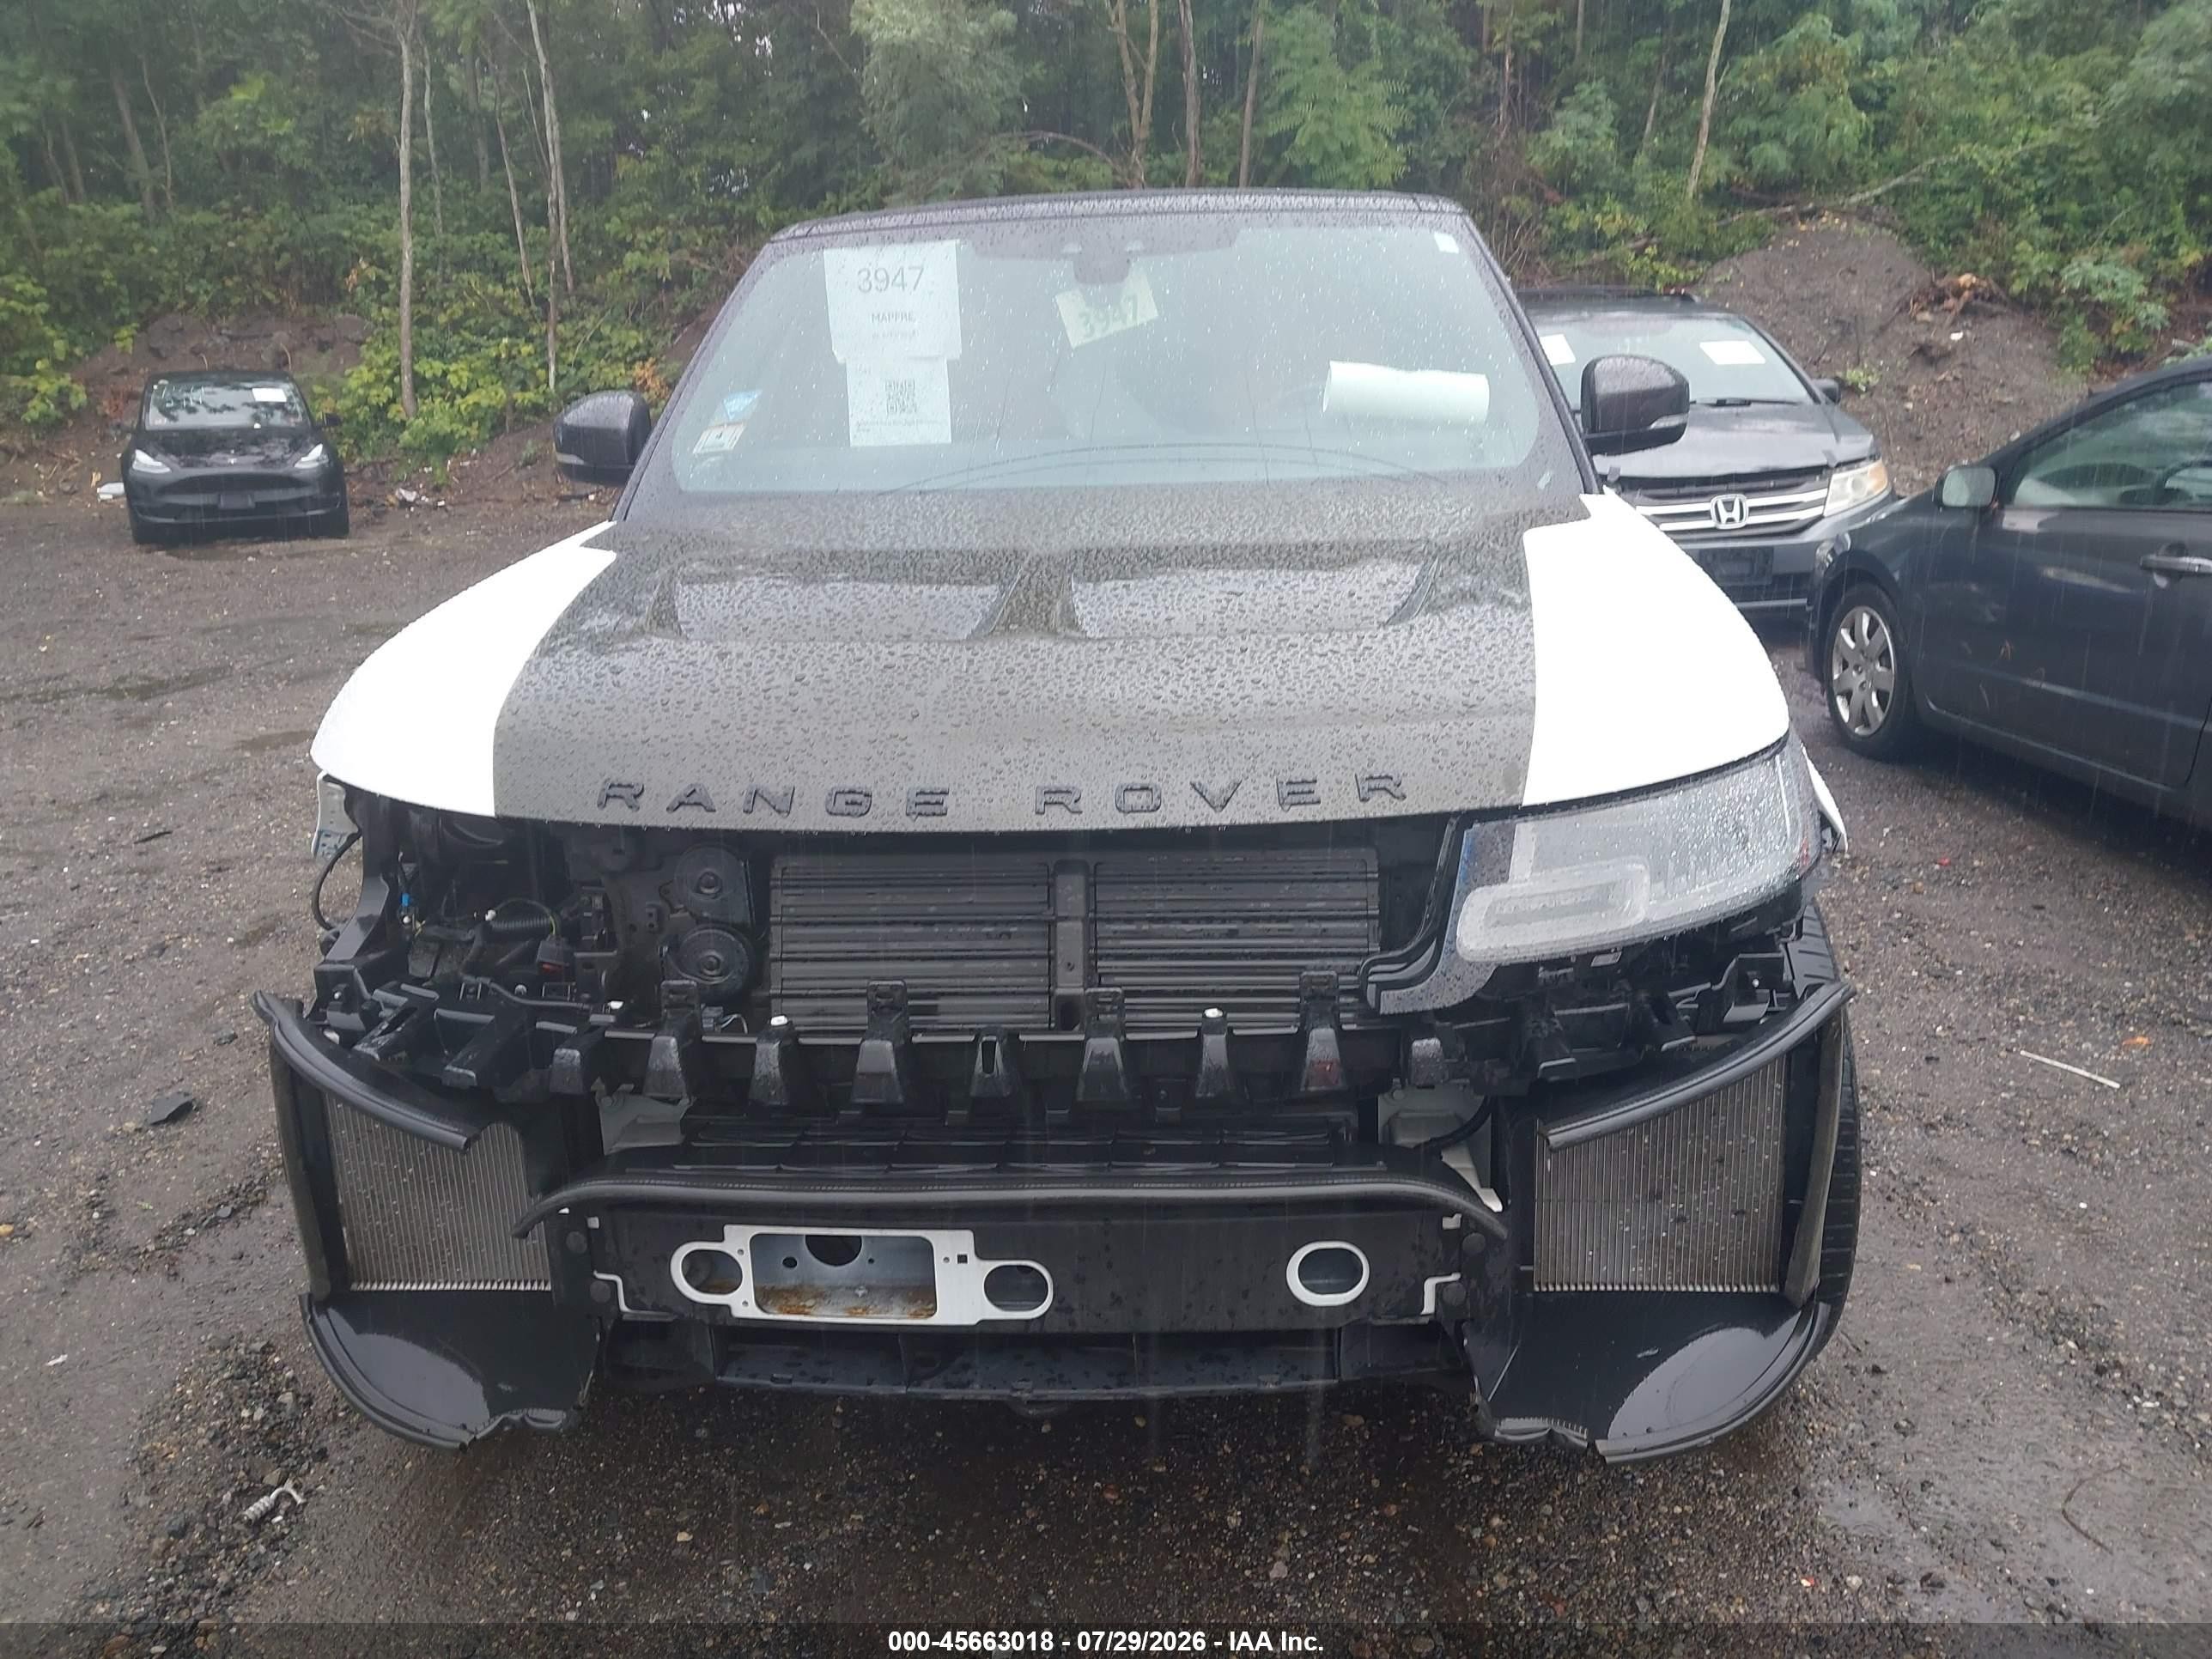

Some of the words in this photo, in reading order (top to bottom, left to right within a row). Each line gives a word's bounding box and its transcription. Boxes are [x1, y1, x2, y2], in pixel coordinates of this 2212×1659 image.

[857, 265, 925, 294] 3947
[596, 781, 950, 819] RANGE
[1034, 773, 1407, 815] ROVER
